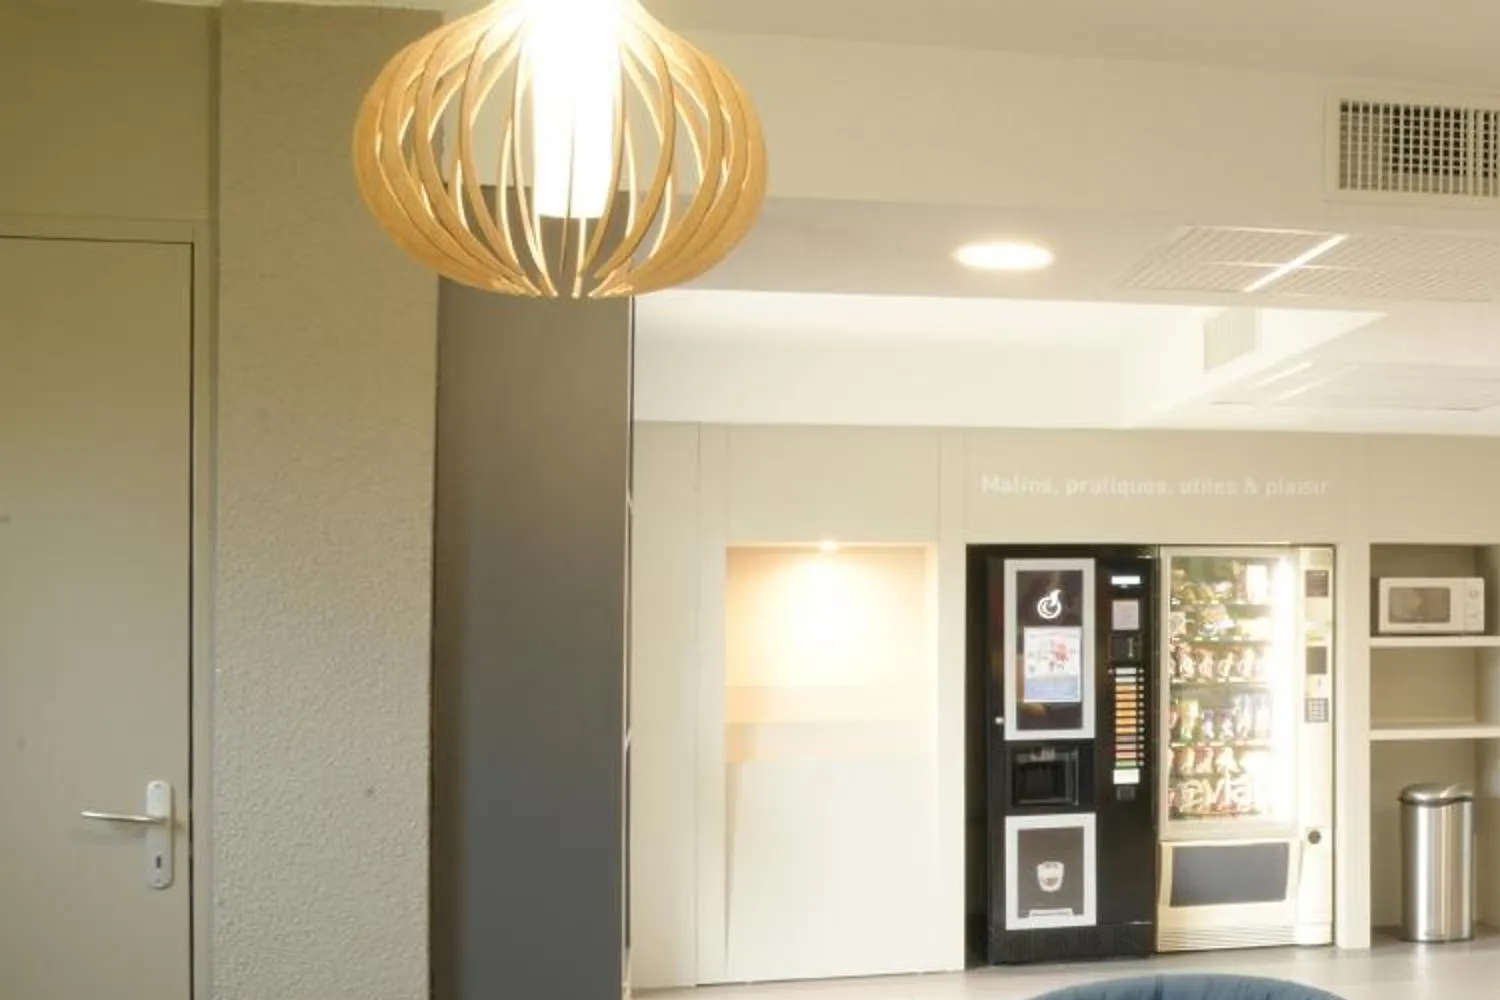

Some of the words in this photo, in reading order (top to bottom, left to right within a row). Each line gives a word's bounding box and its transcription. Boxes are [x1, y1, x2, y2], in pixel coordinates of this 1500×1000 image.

[981, 474, 1059, 498] Malins,
[1066, 476, 1174, 498] pratiques,
[1180, 477, 1238, 495] utiles
[1266, 476, 1331, 499] plaisir
